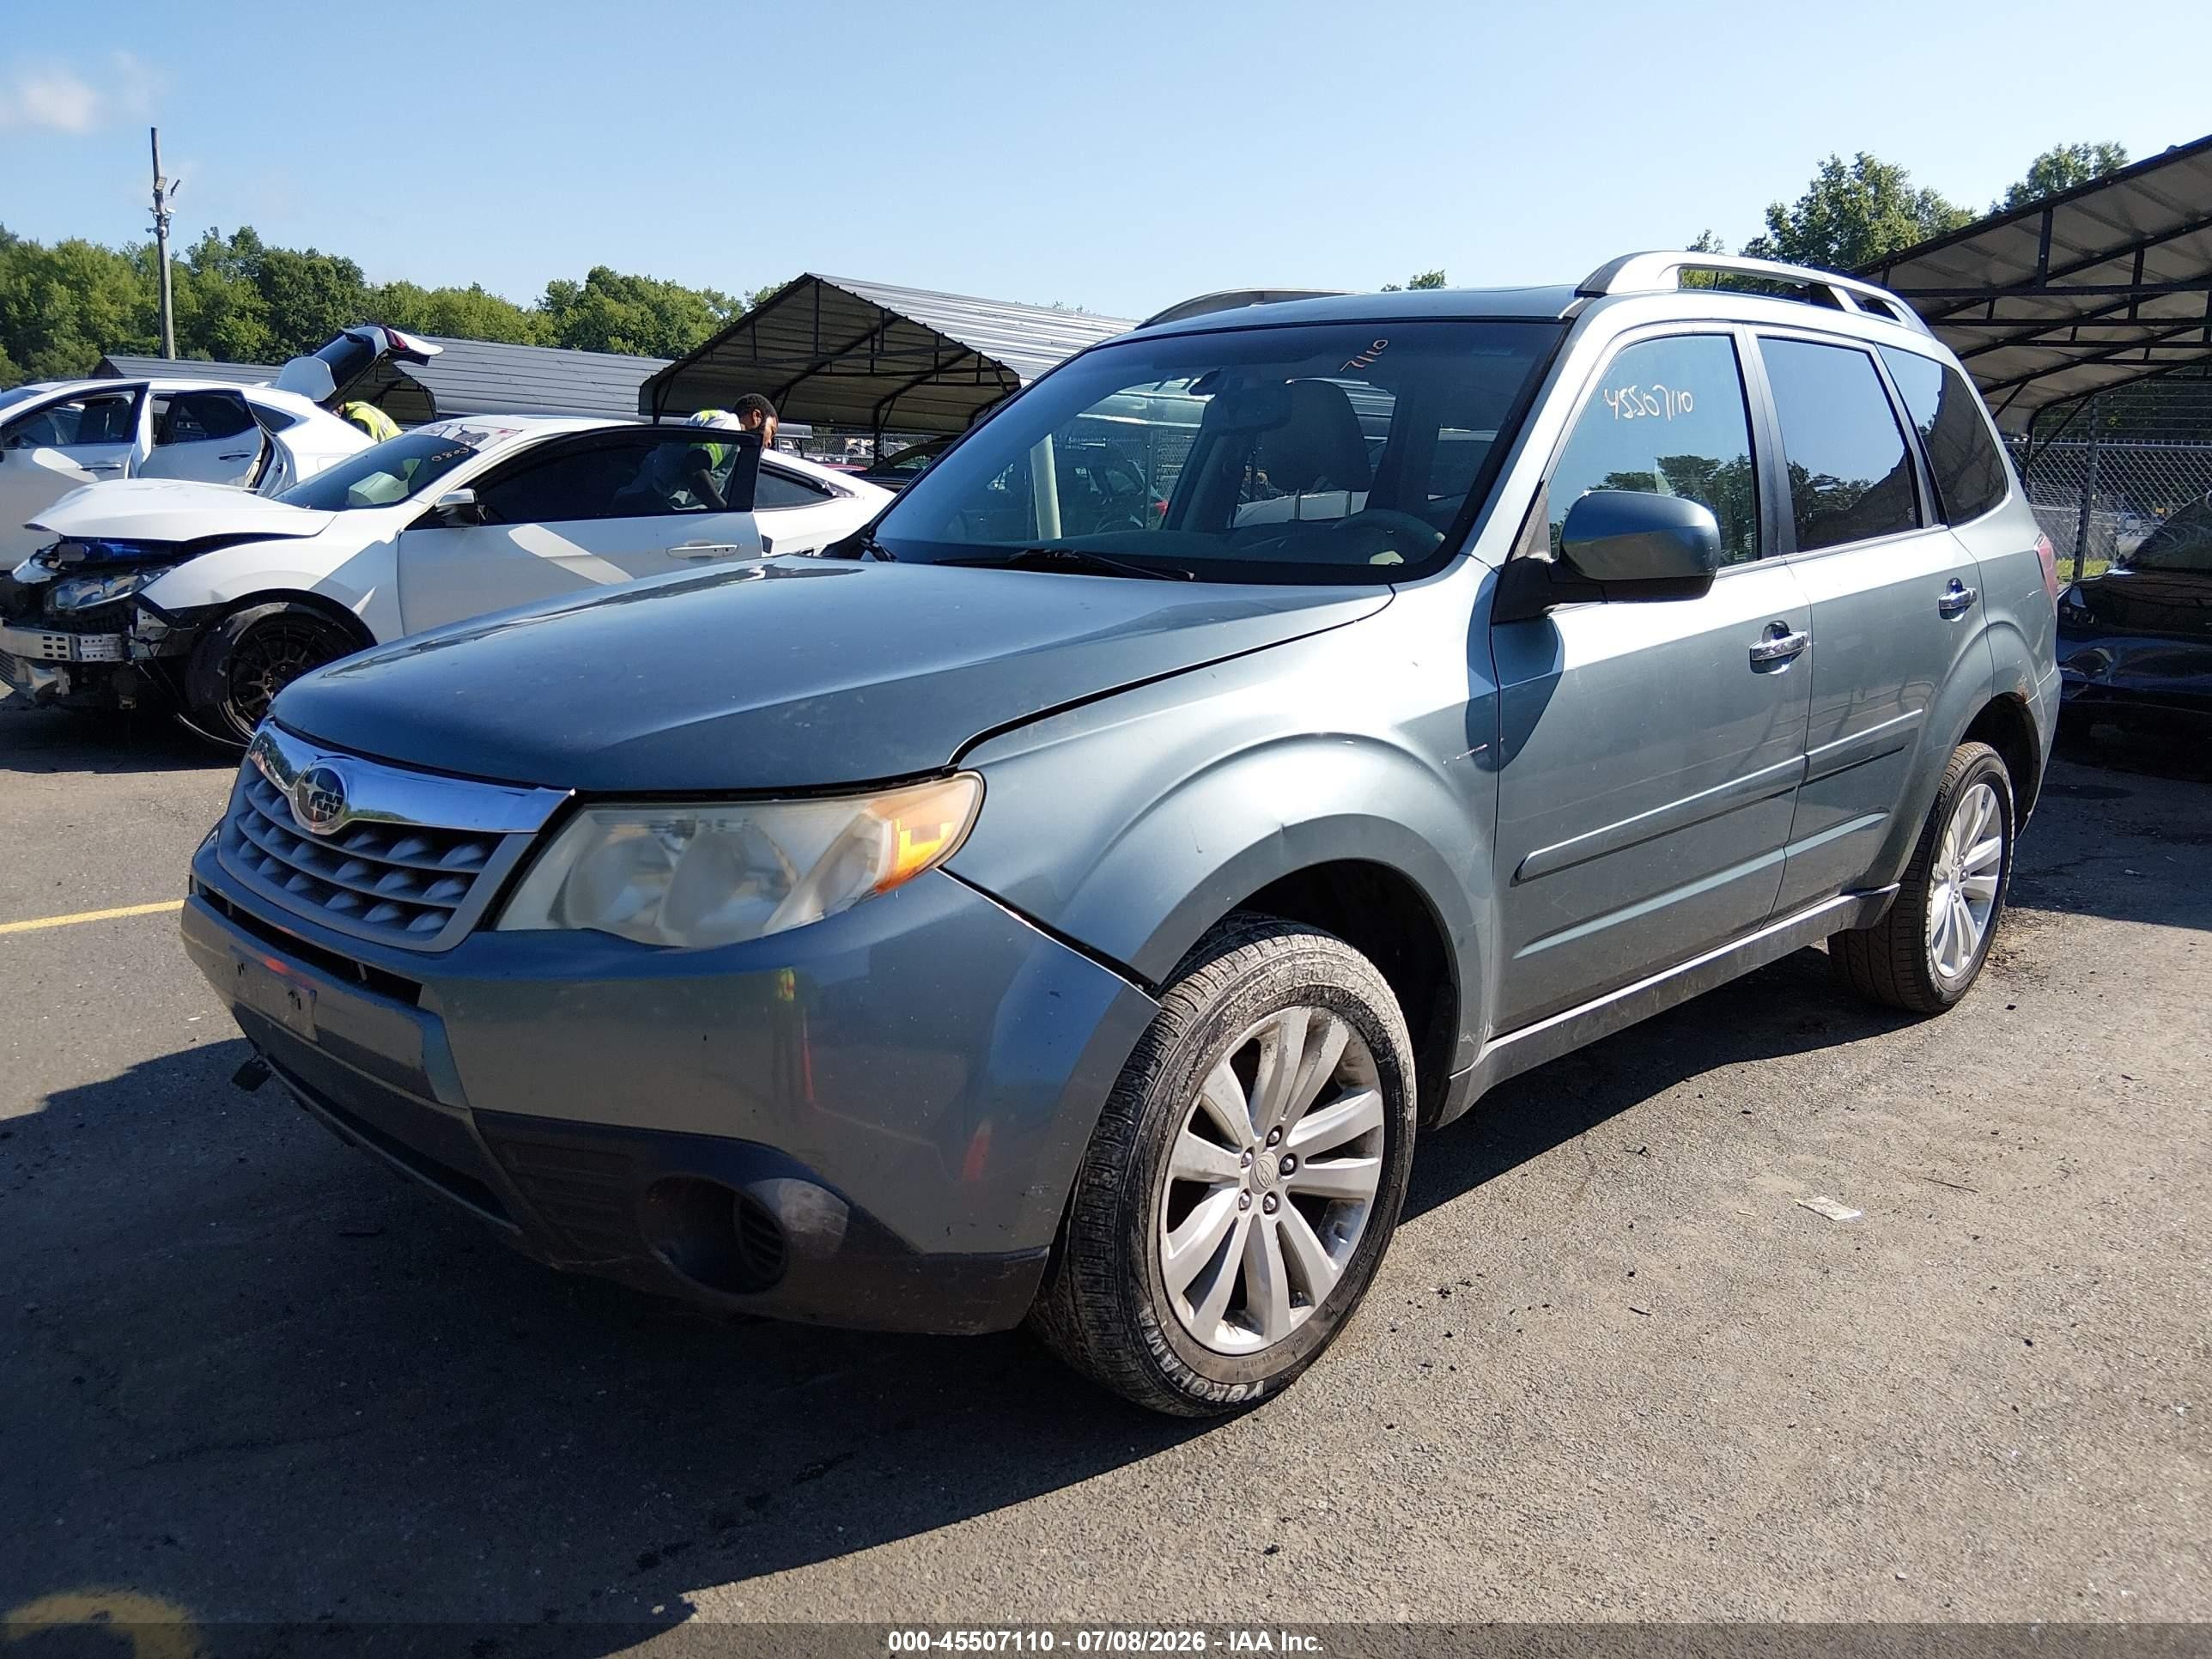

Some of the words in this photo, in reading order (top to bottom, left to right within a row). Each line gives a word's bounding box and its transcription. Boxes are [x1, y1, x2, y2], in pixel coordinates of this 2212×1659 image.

[1339, 339, 1389, 372] 7110
[1604, 384, 1694, 422] 45507110
[1139, 1306, 1265, 1403] YOKOHAMA
